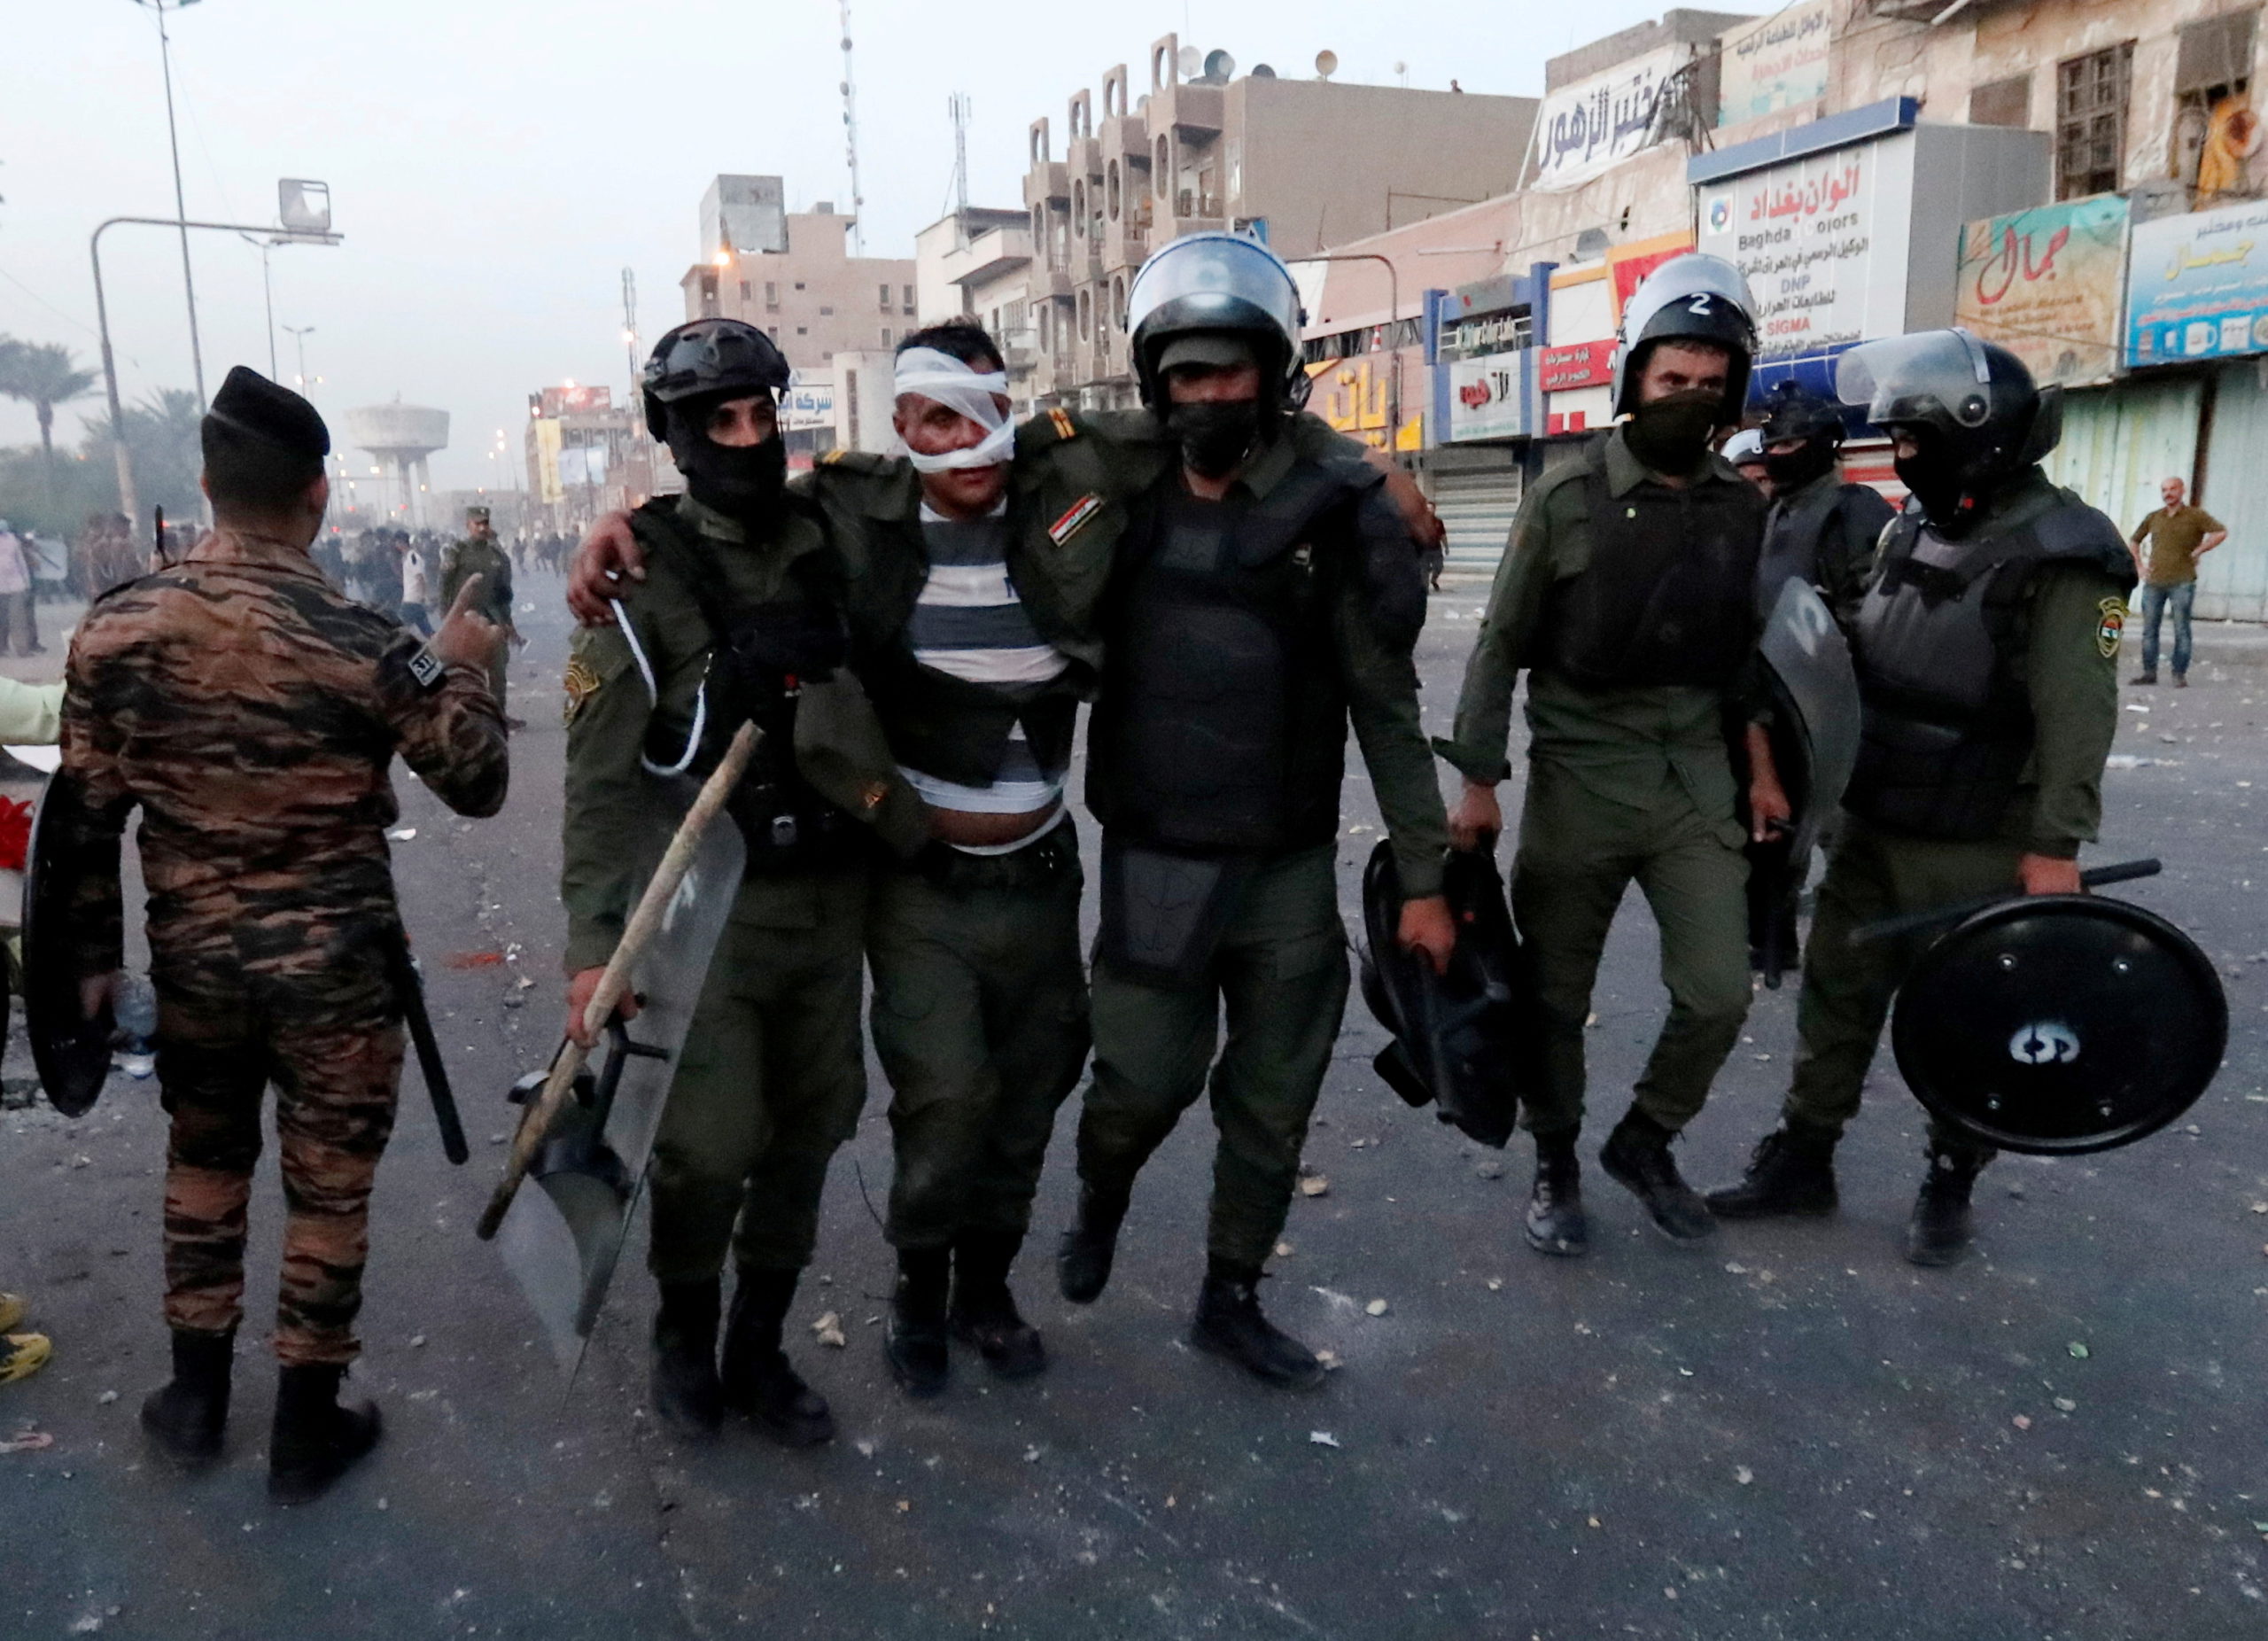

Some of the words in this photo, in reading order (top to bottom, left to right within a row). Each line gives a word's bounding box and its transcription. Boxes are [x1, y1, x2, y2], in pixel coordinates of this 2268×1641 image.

[1751, 181, 1804, 224] بغداد
[1805, 243, 1837, 268] الرسمي
[1837, 237, 1868, 259] الوكيل
[1977, 224, 2070, 305] جمال
[1781, 274, 1811, 294] DNP
[1689, 292, 1711, 315] 2
[1767, 315, 1811, 336] SIGMA
[796, 389, 833, 415] شركة
